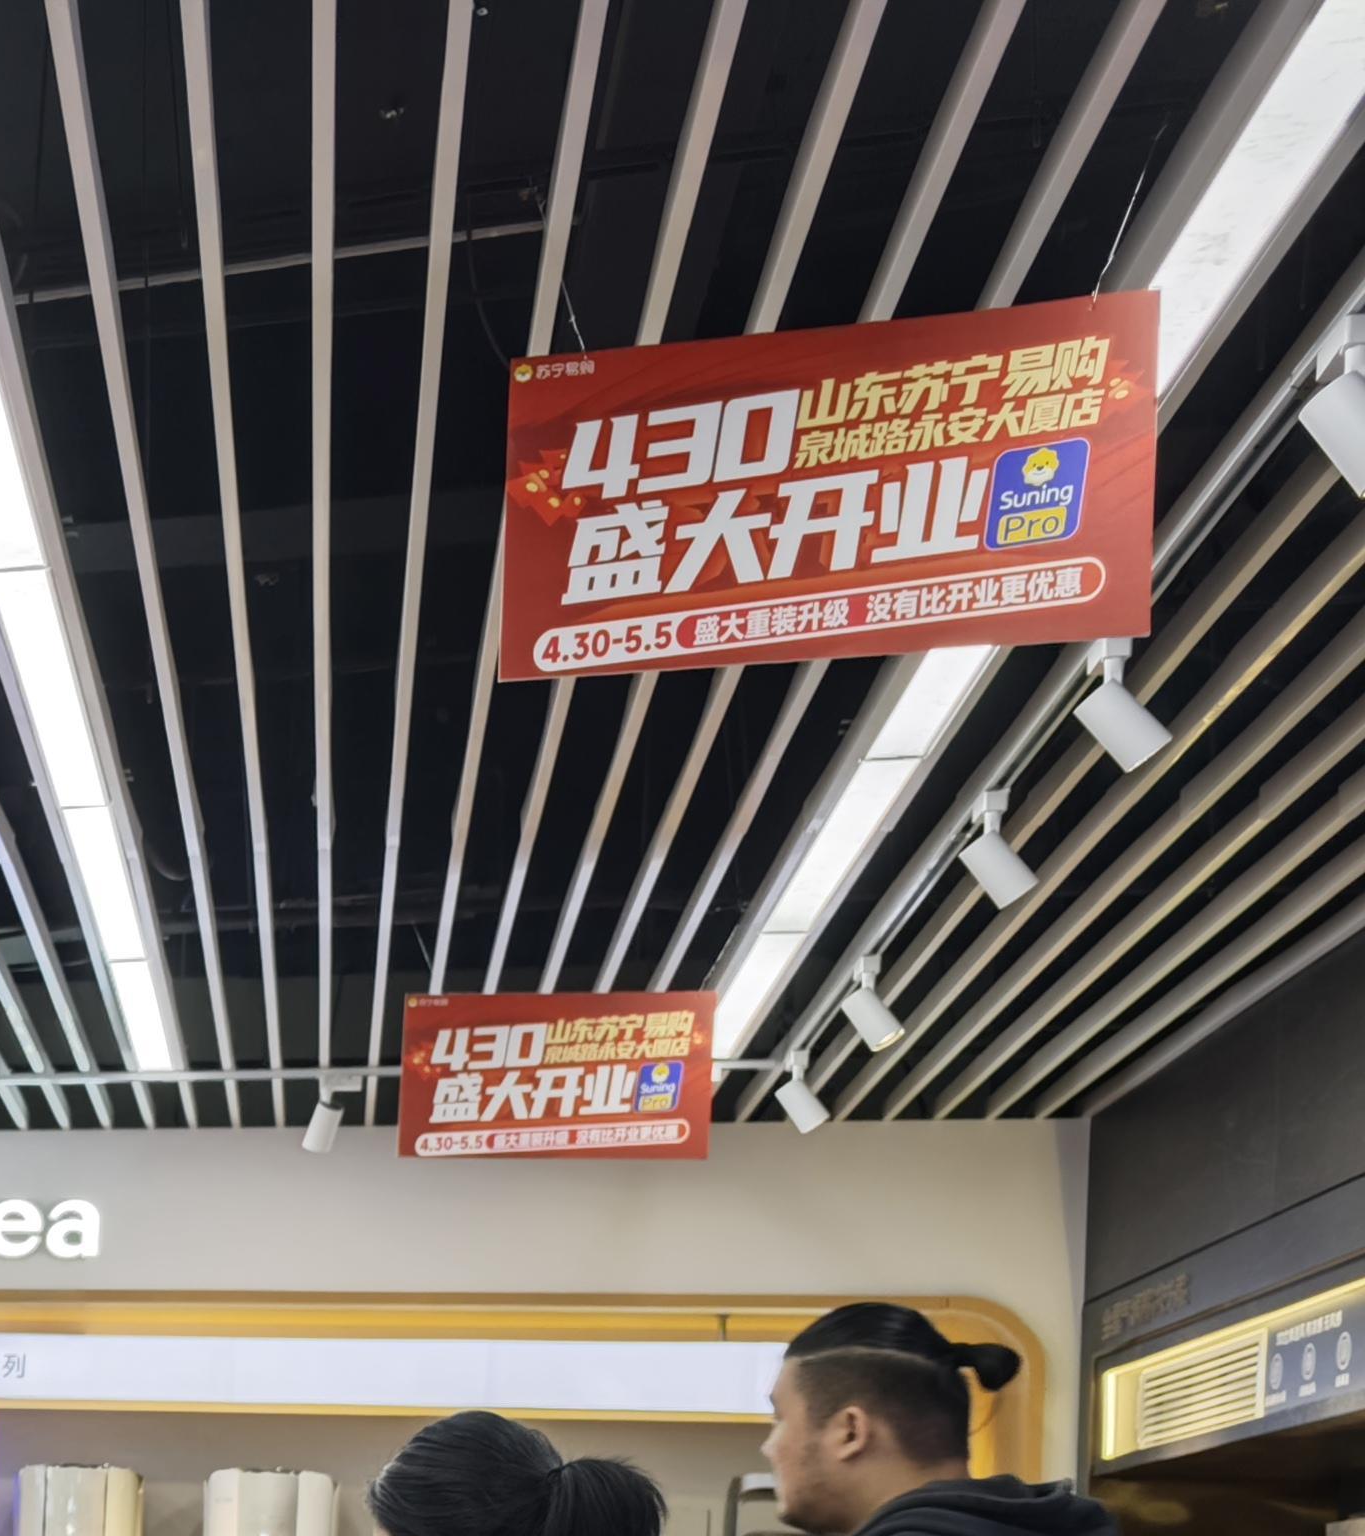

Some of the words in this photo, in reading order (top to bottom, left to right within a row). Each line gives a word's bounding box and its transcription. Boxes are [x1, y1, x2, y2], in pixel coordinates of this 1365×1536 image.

[535, 360, 595, 380] 苏宁易购
[797, 336, 1110, 429] 山东苏宁易购
[562, 388, 800, 498] 430
[795, 388, 1103, 470] 泉城路永安大厦店
[560, 457, 991, 605] 盛大开业
[999, 481, 1073, 514] Suning
[1003, 511, 1060, 544] Pro
[542, 623, 672, 664] 4.30-5.5
[694, 598, 850, 645] 盛大重装升级
[866, 568, 1082, 623] 没有比开业更优惠
[430, 1022, 547, 1071] 430
[429, 1064, 637, 1123] 盛大开业
